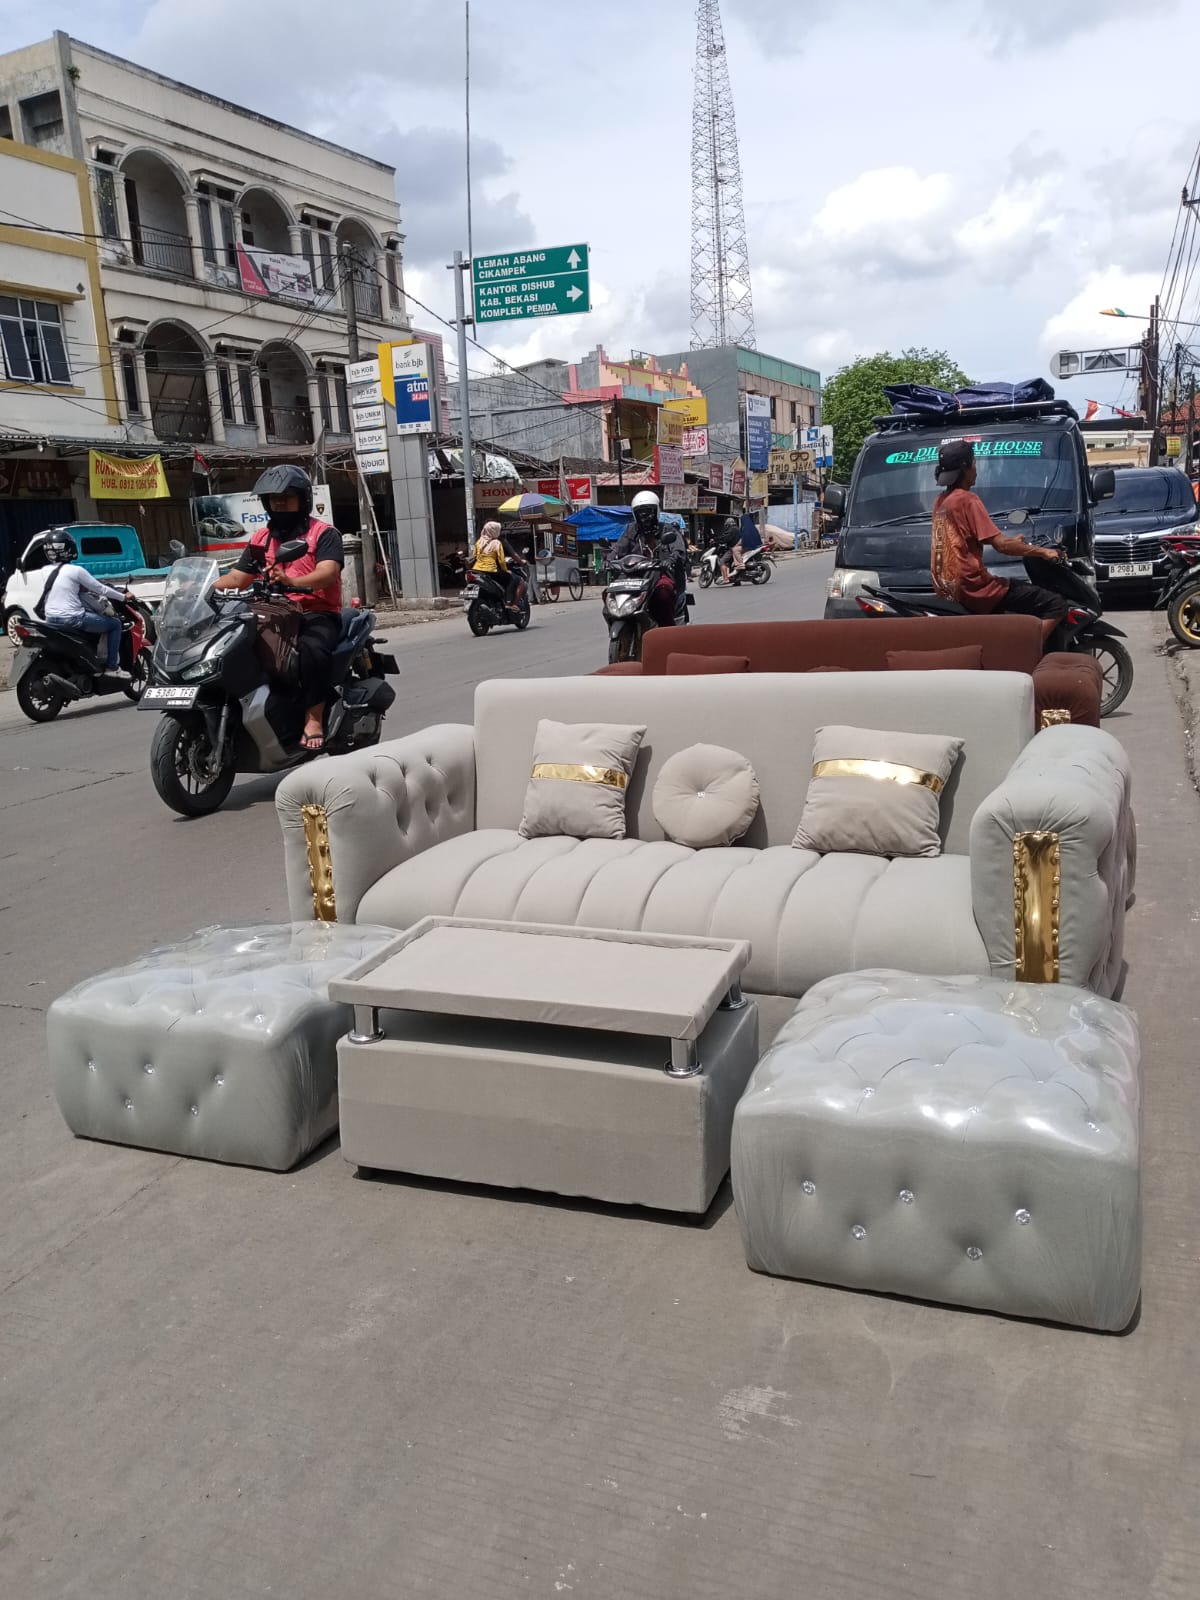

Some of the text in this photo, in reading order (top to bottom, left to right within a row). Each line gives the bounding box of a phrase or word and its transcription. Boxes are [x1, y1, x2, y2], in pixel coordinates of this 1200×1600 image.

[478, 253, 546, 269] LEMAH ABANG
[478, 266, 526, 279] CIKAMPEK
[479, 280, 555, 296] KANTOR DISHUB
[480, 293, 538, 307] KAB. BEKASI
[480, 307, 523, 318] KOMPLEK
[527, 303, 557, 313] PEMDA
[395, 358, 424, 369] bank bjb
[406, 380, 428, 393] atm
[992, 440, 1043, 451] HOUSE
[770, 461, 813, 472] TRIO JAYA
[241, 511, 271, 524] Fast
[146, 689, 153, 698] B
